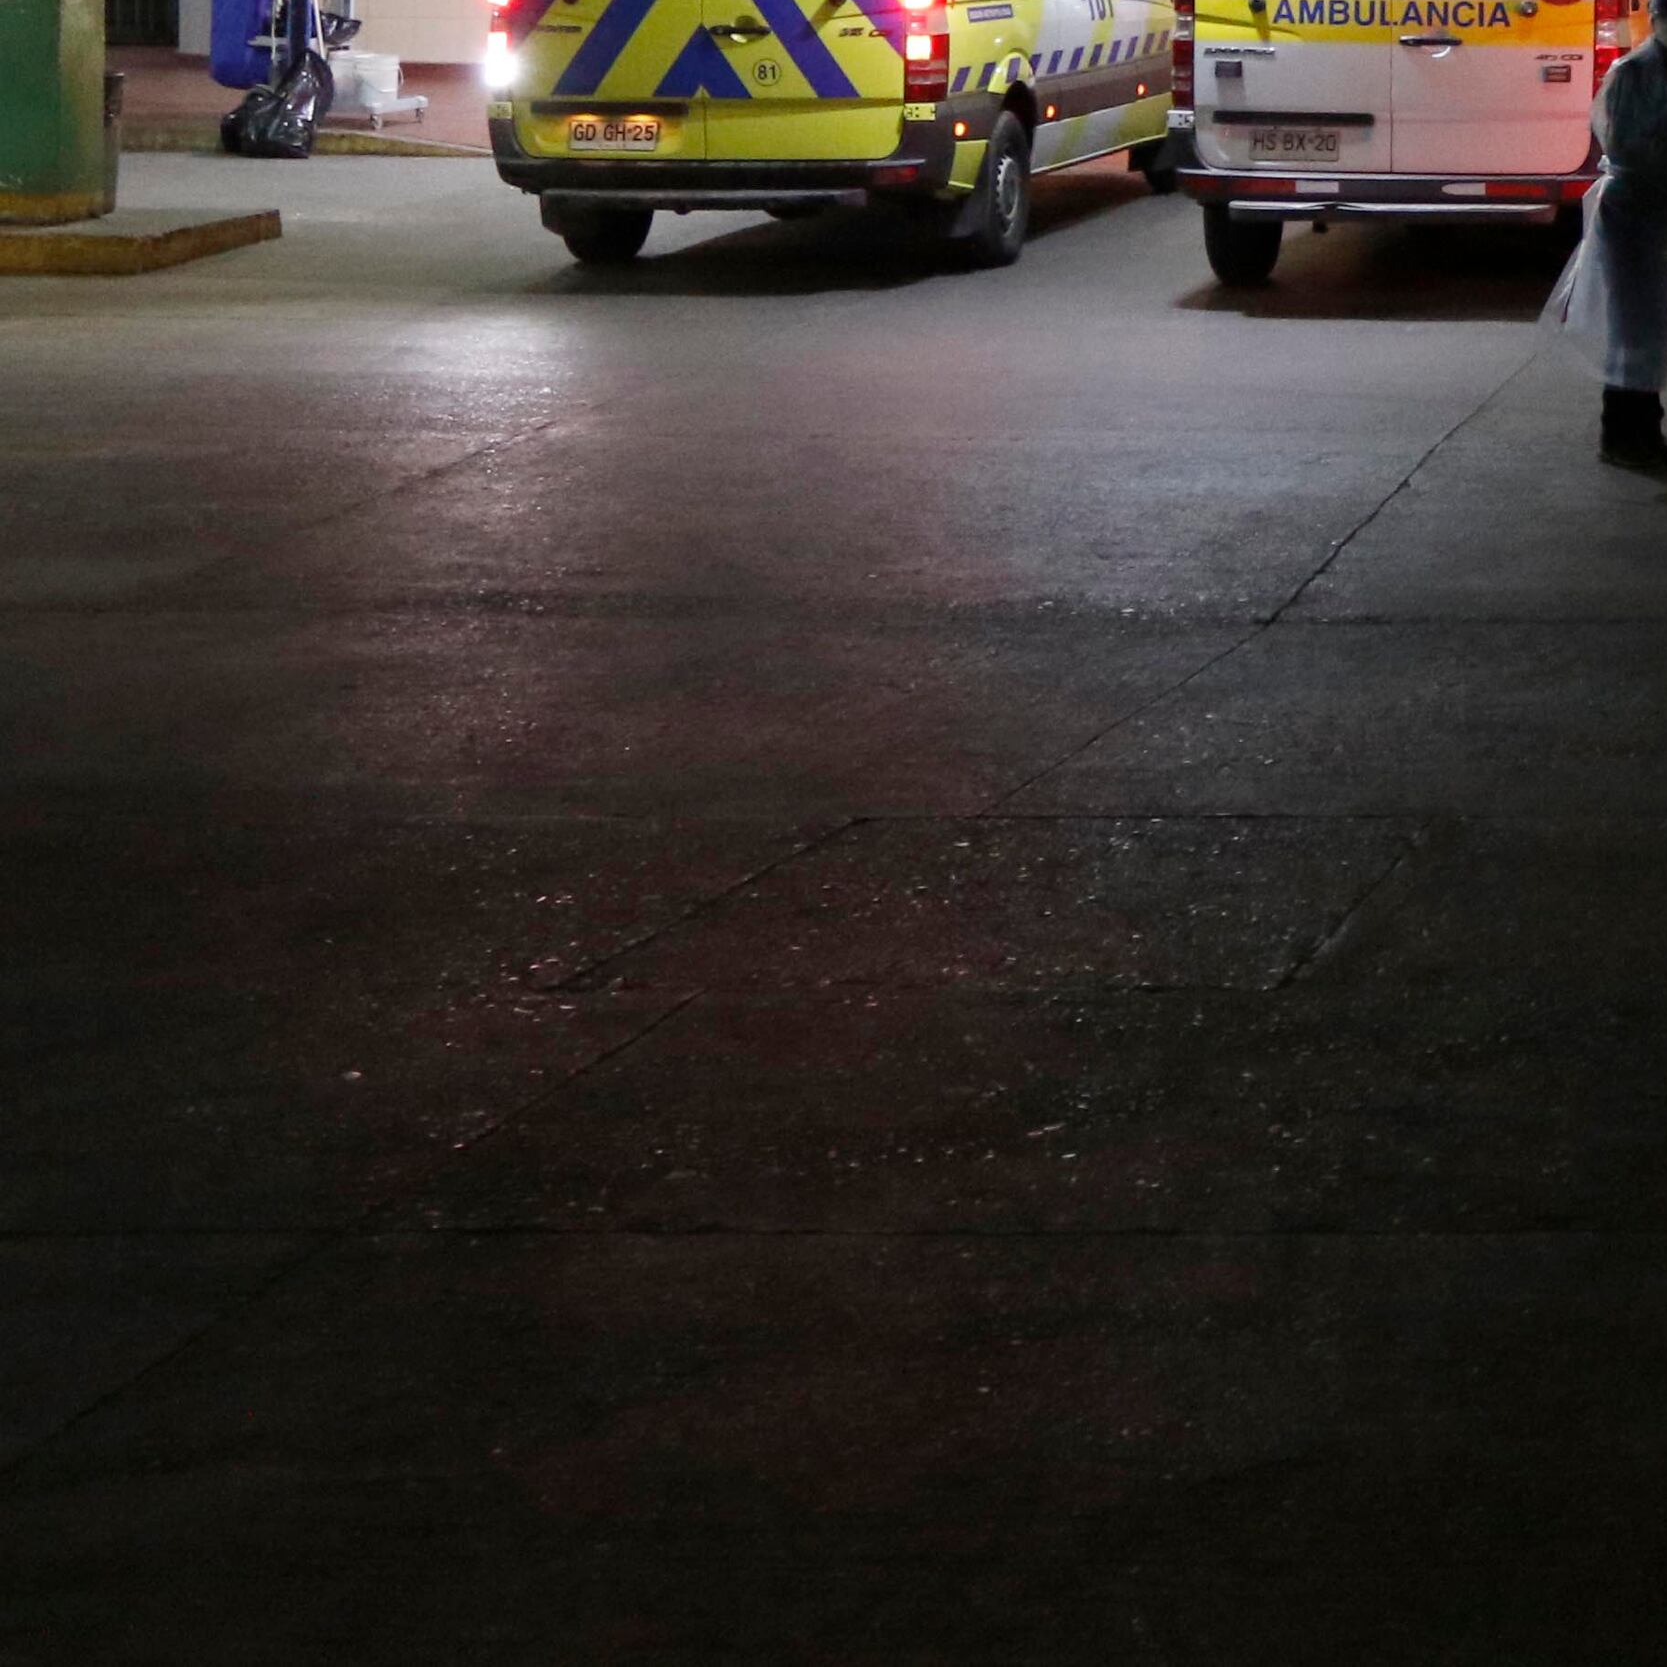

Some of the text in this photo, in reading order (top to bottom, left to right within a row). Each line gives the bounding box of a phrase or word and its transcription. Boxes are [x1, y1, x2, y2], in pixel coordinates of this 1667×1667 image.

[1273, 0, 1511, 27] AMBULANCIA
[757, 64, 776, 81] 81
[573, 123, 597, 141] GD
[1253, 133, 1275, 151] HS
